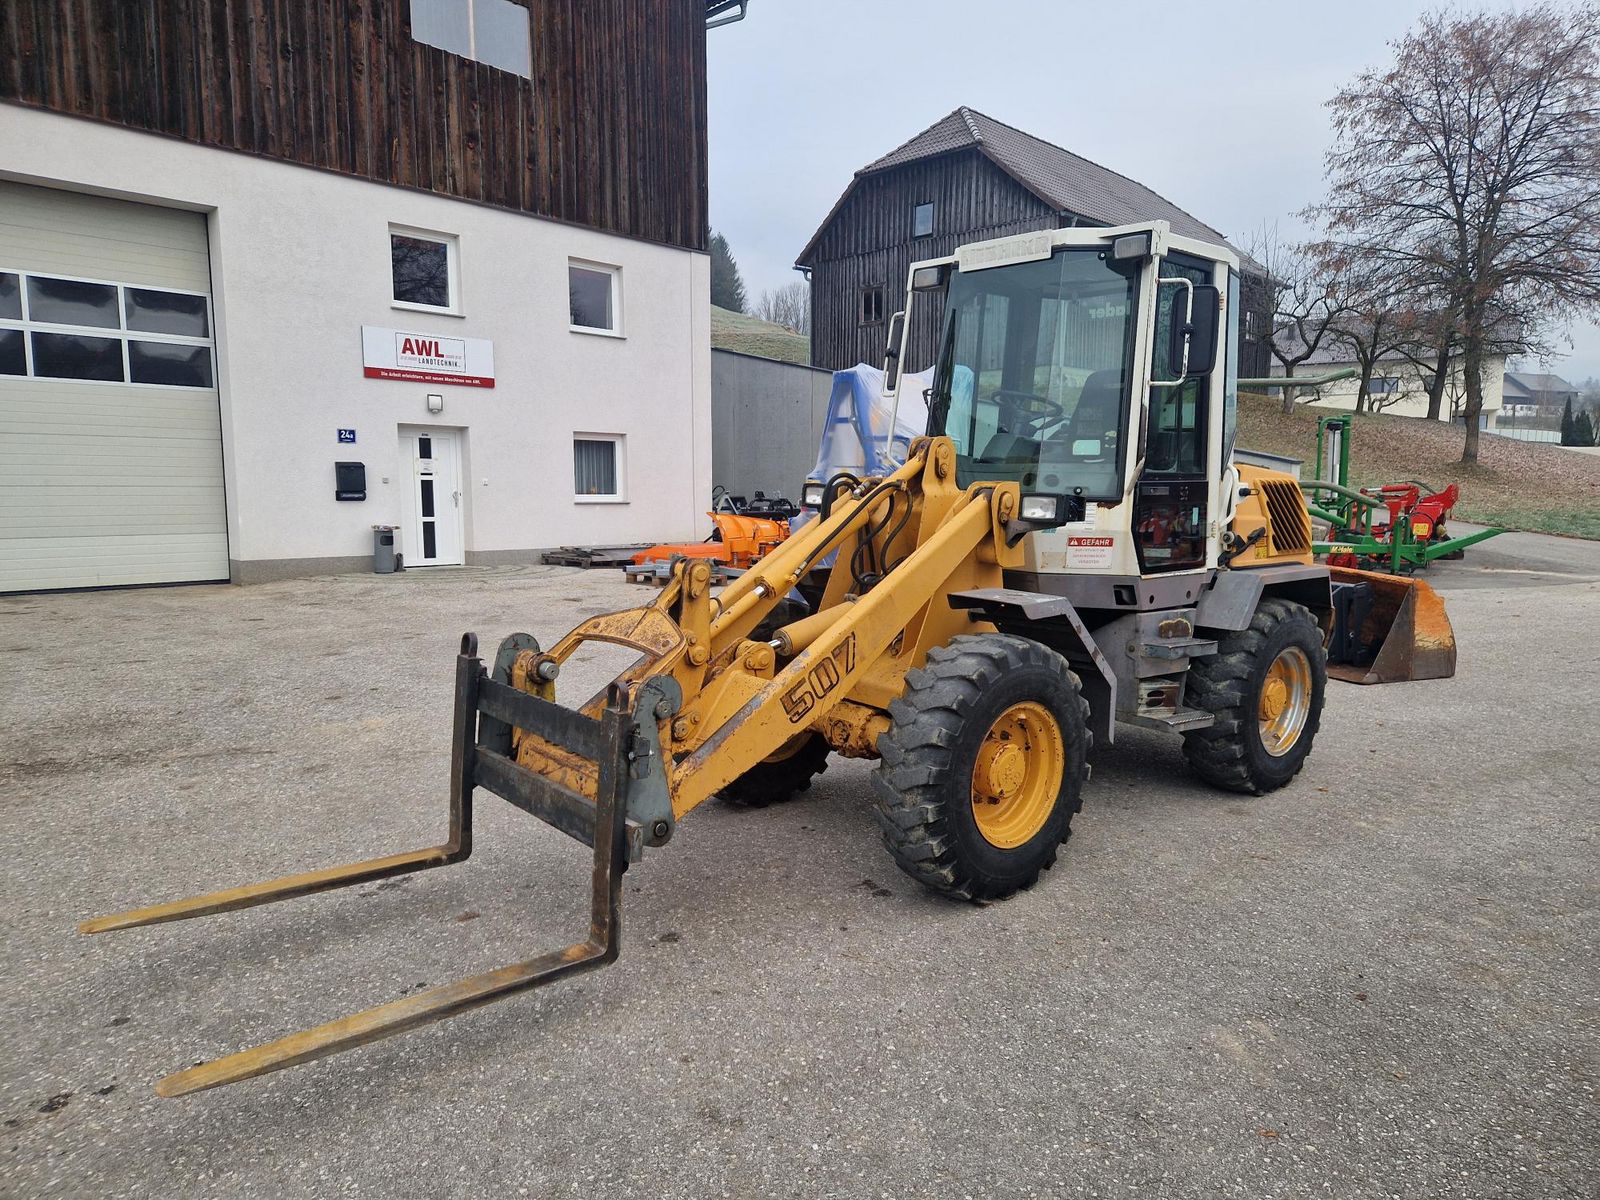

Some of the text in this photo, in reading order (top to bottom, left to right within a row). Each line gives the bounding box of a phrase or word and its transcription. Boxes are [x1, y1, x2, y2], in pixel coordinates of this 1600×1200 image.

[401, 338, 445, 358] AWL
[418, 357, 458, 367] LANDTECHNIK
[1081, 538, 1110, 546] GEFAHR
[780, 631, 856, 723] 507
